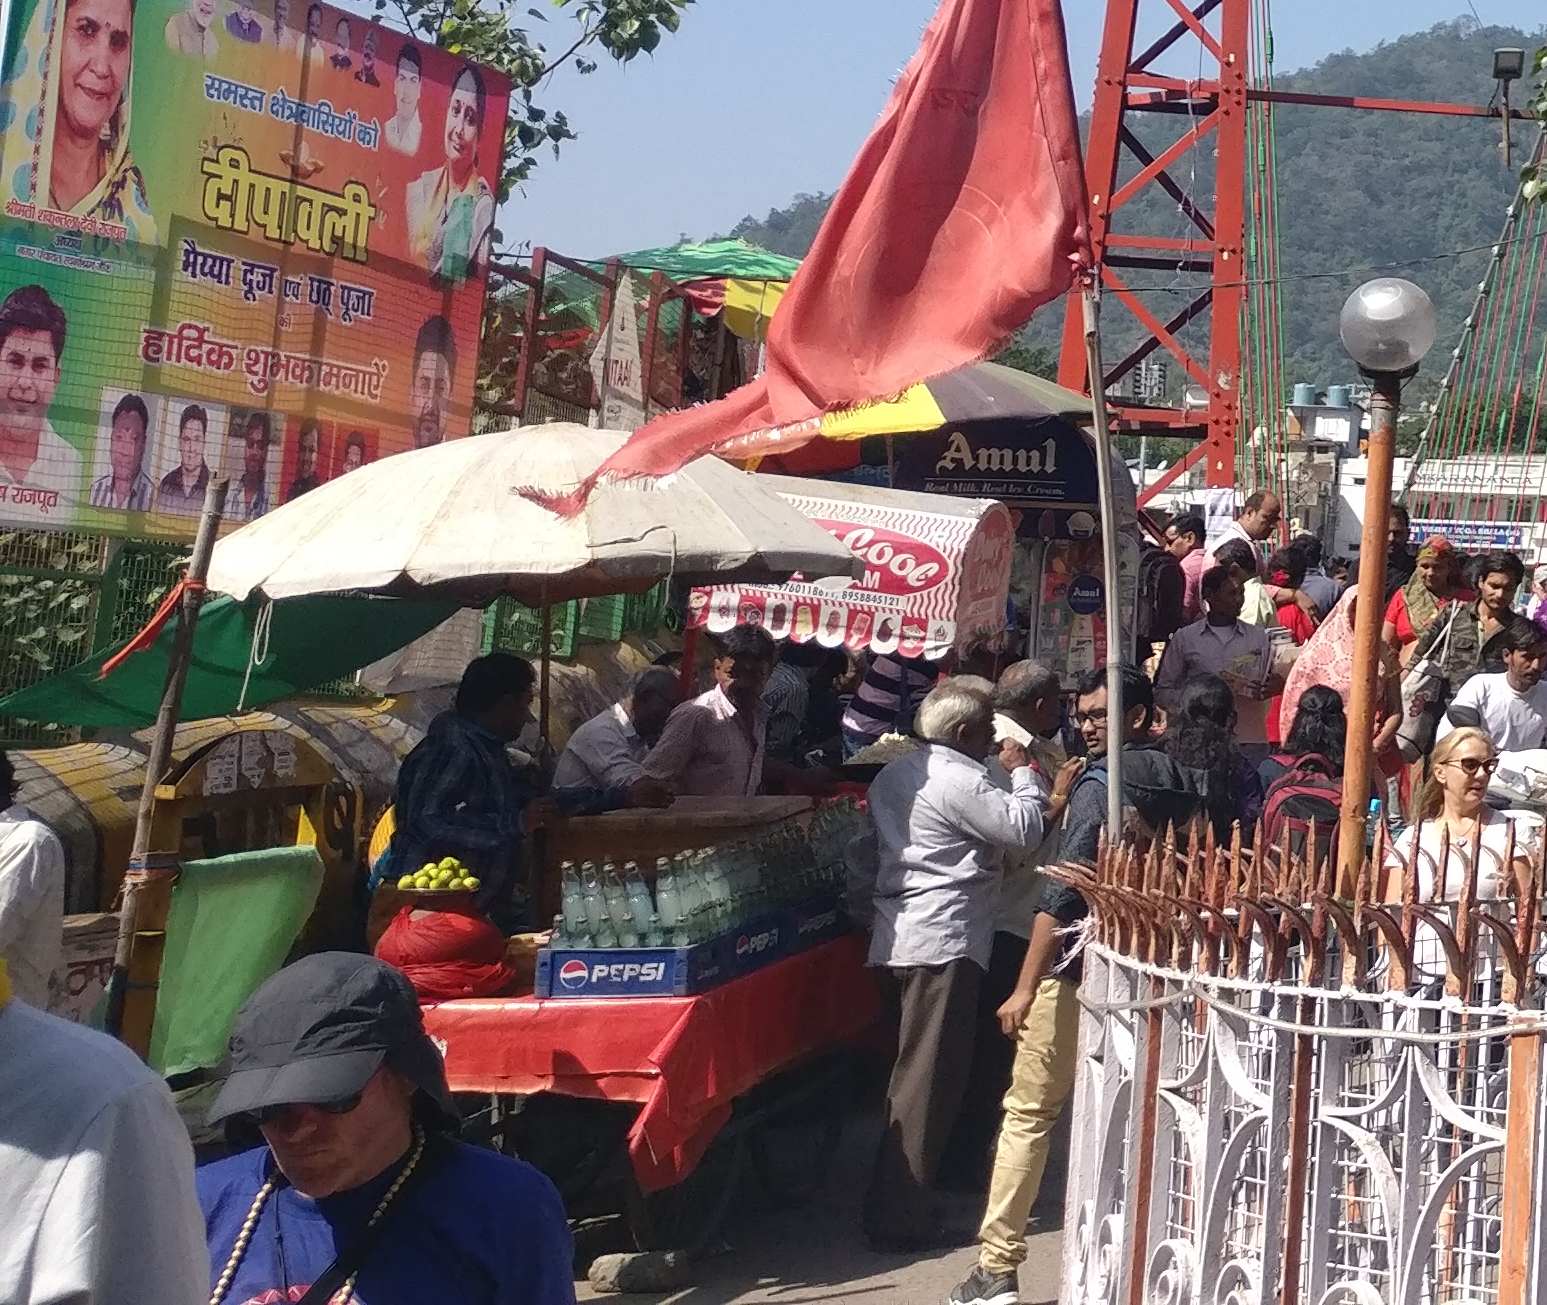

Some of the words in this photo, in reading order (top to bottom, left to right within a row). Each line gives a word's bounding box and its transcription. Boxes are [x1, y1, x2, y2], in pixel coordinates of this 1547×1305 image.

[205, 74, 266, 112] समस्त
[357, 118, 380, 150] को
[201, 145, 376, 263] दीपावली
[240, 261, 278, 303] दूज
[340, 281, 375, 324] पूजा
[141, 322, 240, 371] हार्दिक
[936, 431, 1058, 475] Amul
[12, 487, 59, 514] राजपूत
[590, 962, 666, 983] PEPSI
